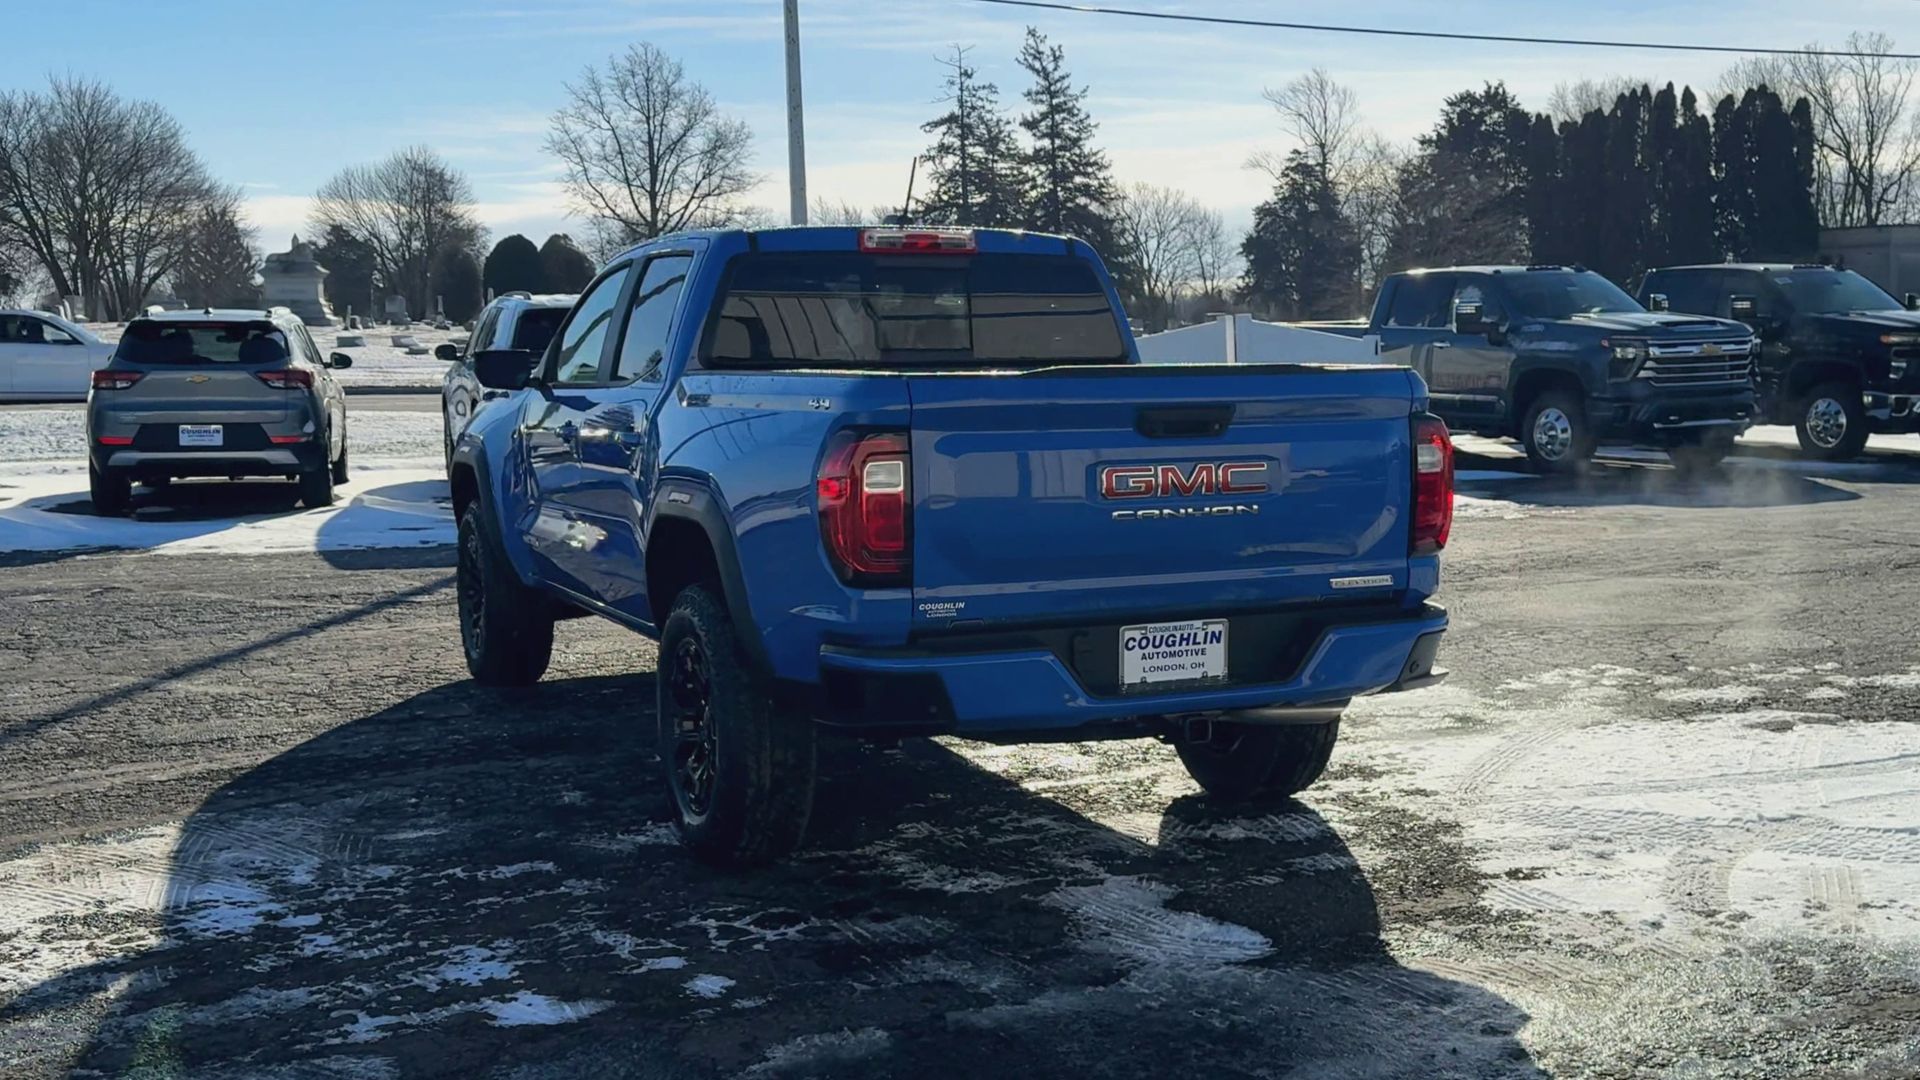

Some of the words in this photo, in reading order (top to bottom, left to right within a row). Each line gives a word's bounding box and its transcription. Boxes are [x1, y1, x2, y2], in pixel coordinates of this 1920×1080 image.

[1103, 462, 1267, 499] GMC
[1112, 505, 1259, 520] CANYON
[919, 601, 965, 611] COUGHLIN
[1124, 630, 1222, 652] COUGHLIN
[1141, 648, 1207, 661] AUTOMOTIVE
[1142, 663, 1188, 673] LONDON,
[1190, 661, 1205, 670] OH
